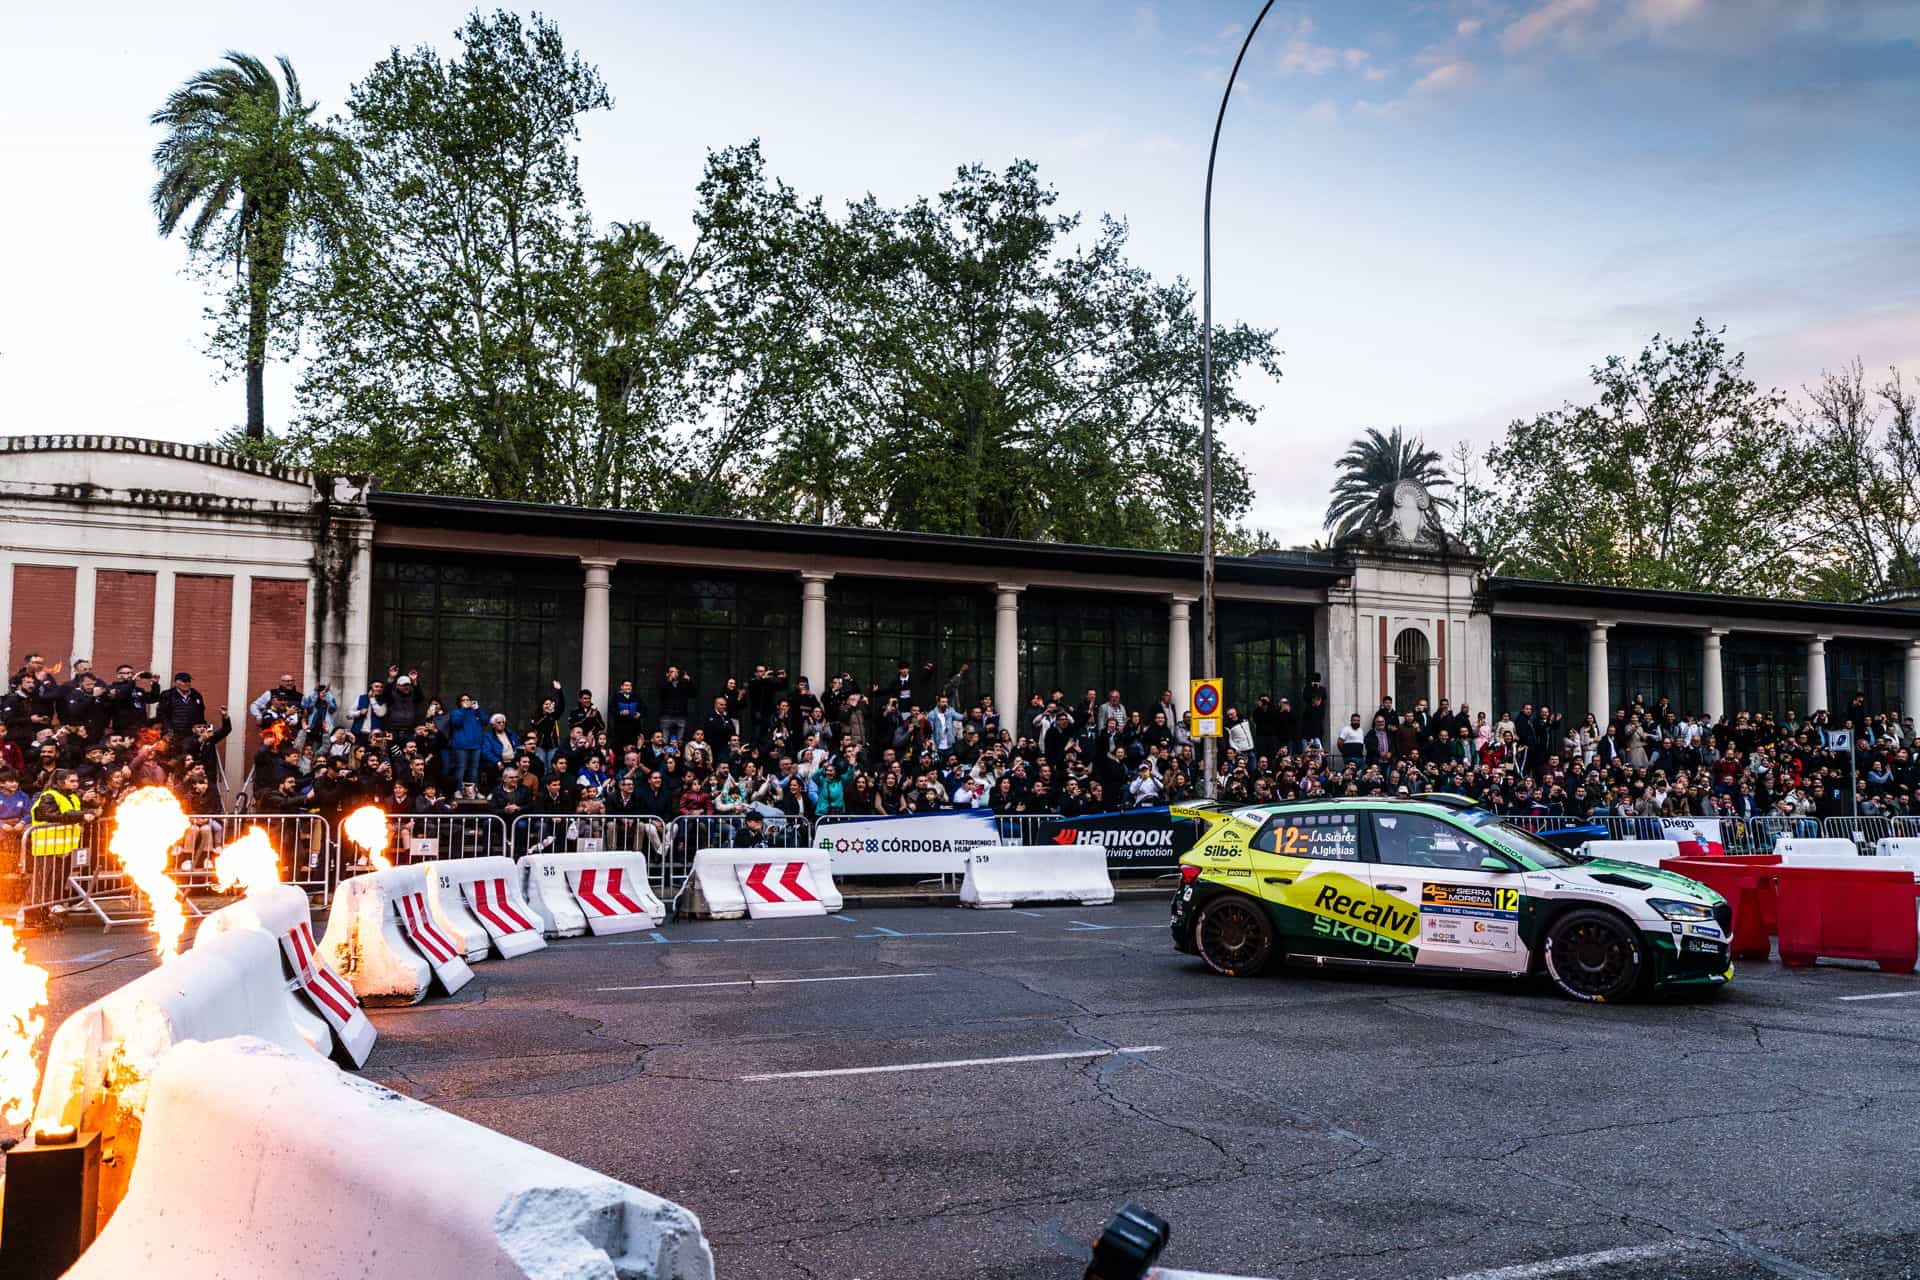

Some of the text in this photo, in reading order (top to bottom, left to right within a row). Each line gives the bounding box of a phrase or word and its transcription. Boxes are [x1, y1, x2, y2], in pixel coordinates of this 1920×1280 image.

[1661, 818, 1695, 831] Diego
[881, 836, 952, 853] CÓRDOBA
[1273, 826, 1299, 854] 12
[1104, 847, 1173, 859] riving emotion
[1448, 894, 1492, 903] MORENA
[1456, 888, 1492, 897] SIERRA
[1496, 888, 1518, 911] 12
[1314, 885, 1418, 935] Recalvi
